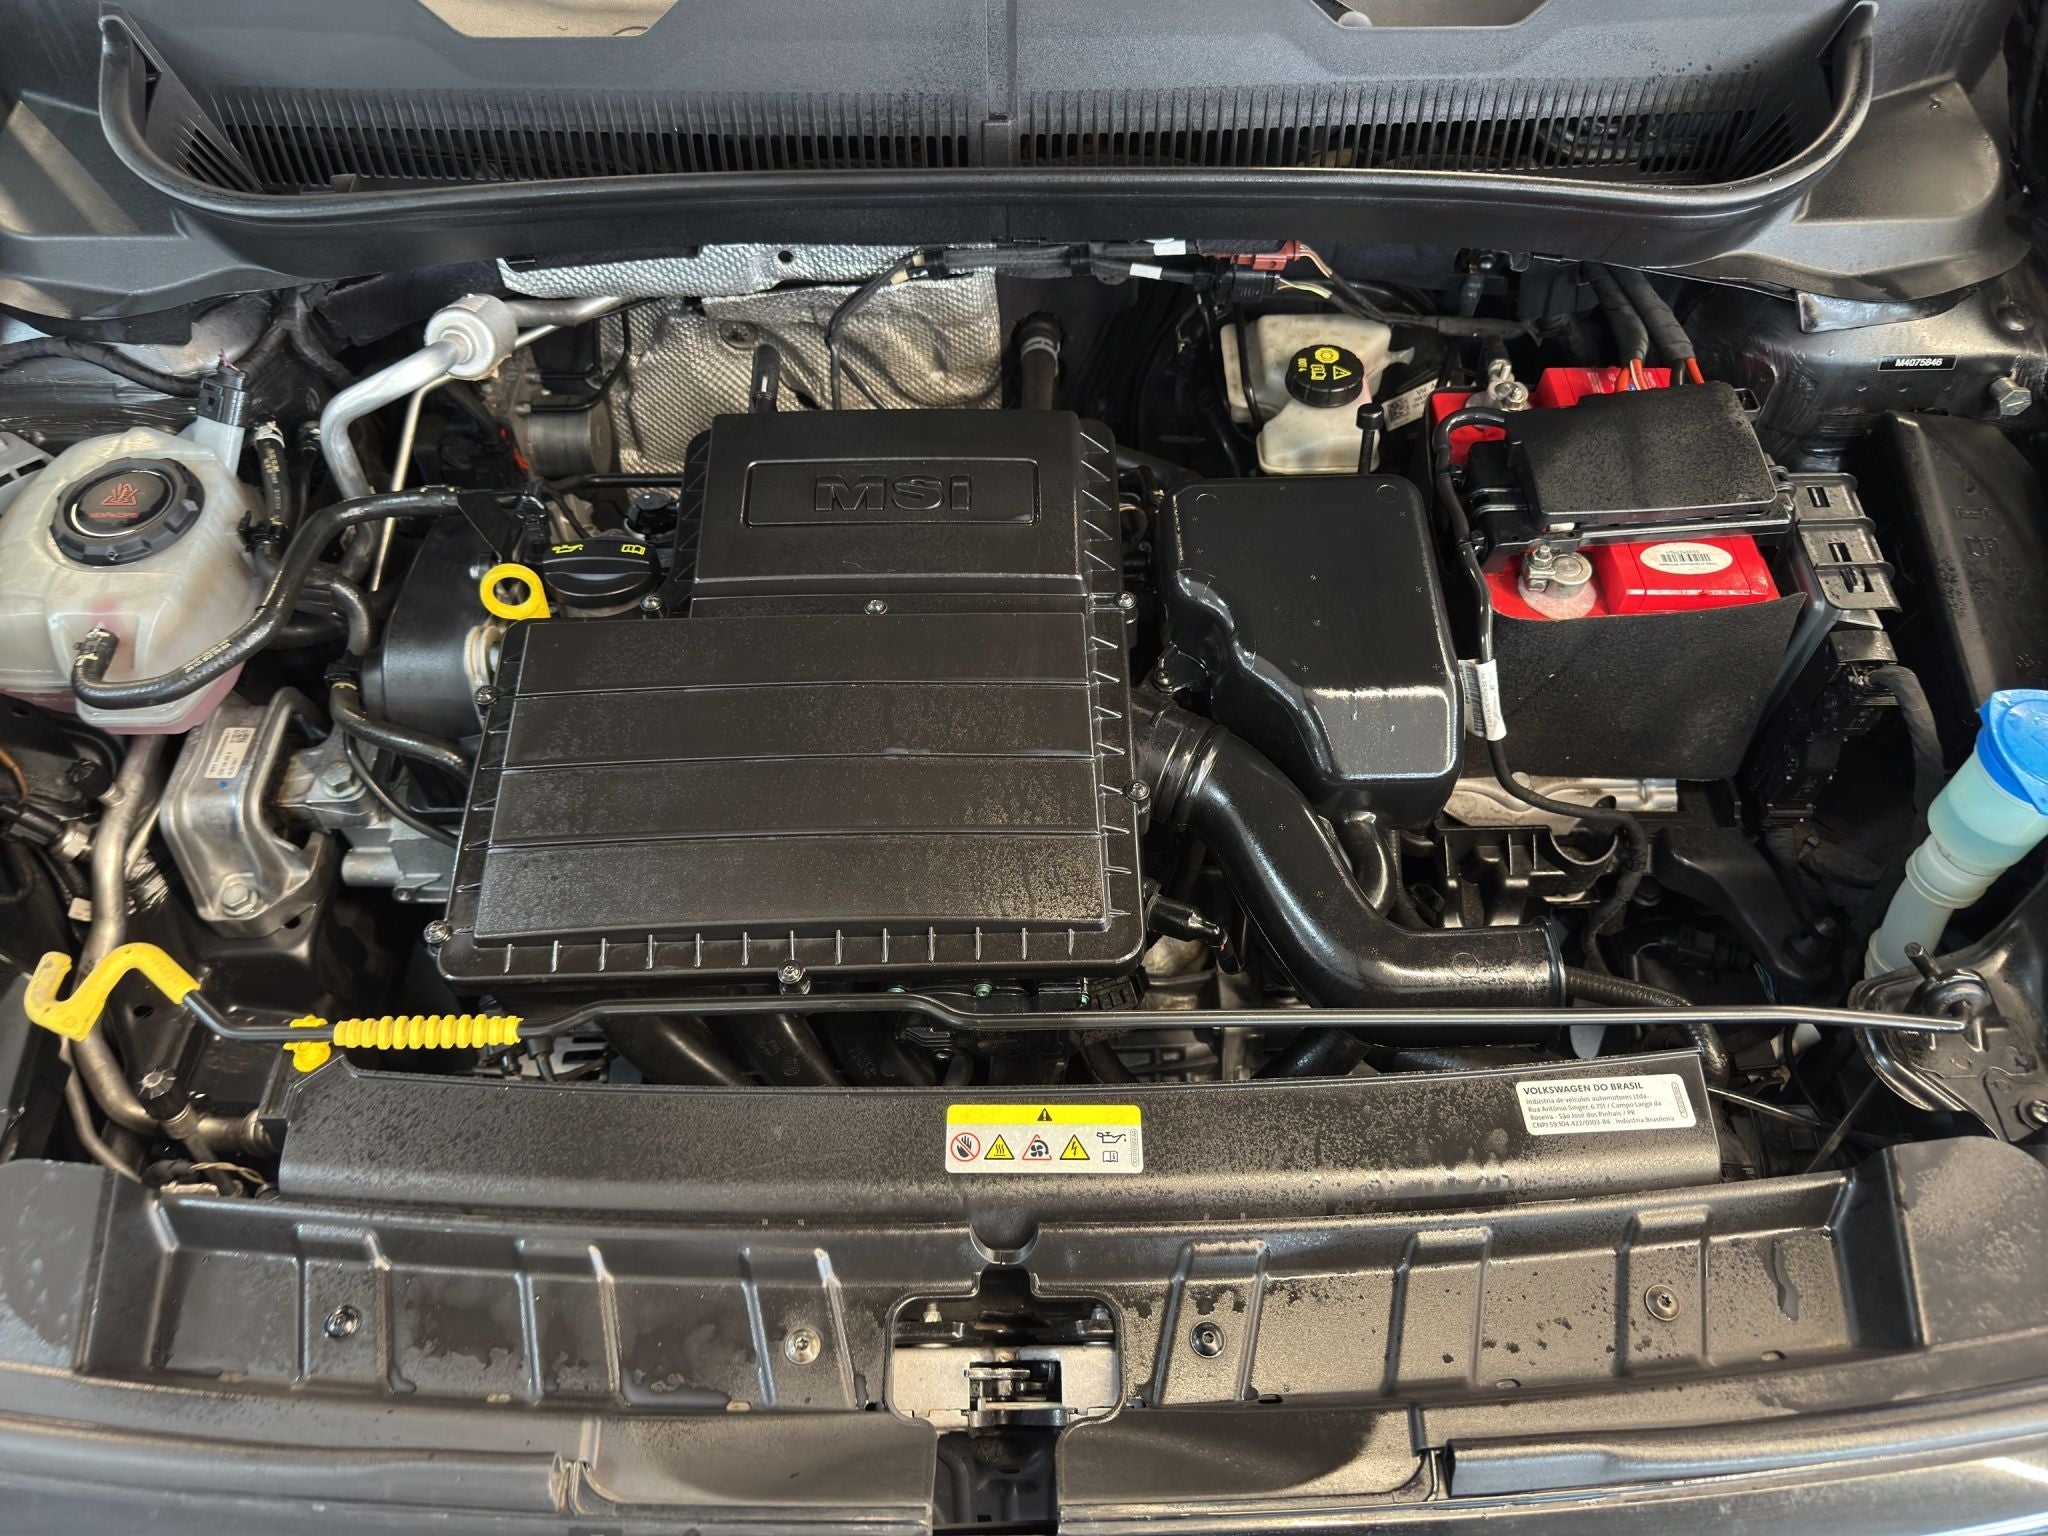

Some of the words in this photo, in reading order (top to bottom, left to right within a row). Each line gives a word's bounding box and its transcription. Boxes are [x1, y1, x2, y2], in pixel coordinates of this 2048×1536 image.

[1895, 358, 1943, 367] M4075846
[815, 474, 972, 511] MSI
[1523, 1084, 1591, 1095] VOLKSWAGEN
[1593, 1083, 1608, 1092] DO
[1610, 1082, 1644, 1091] BRASIL
